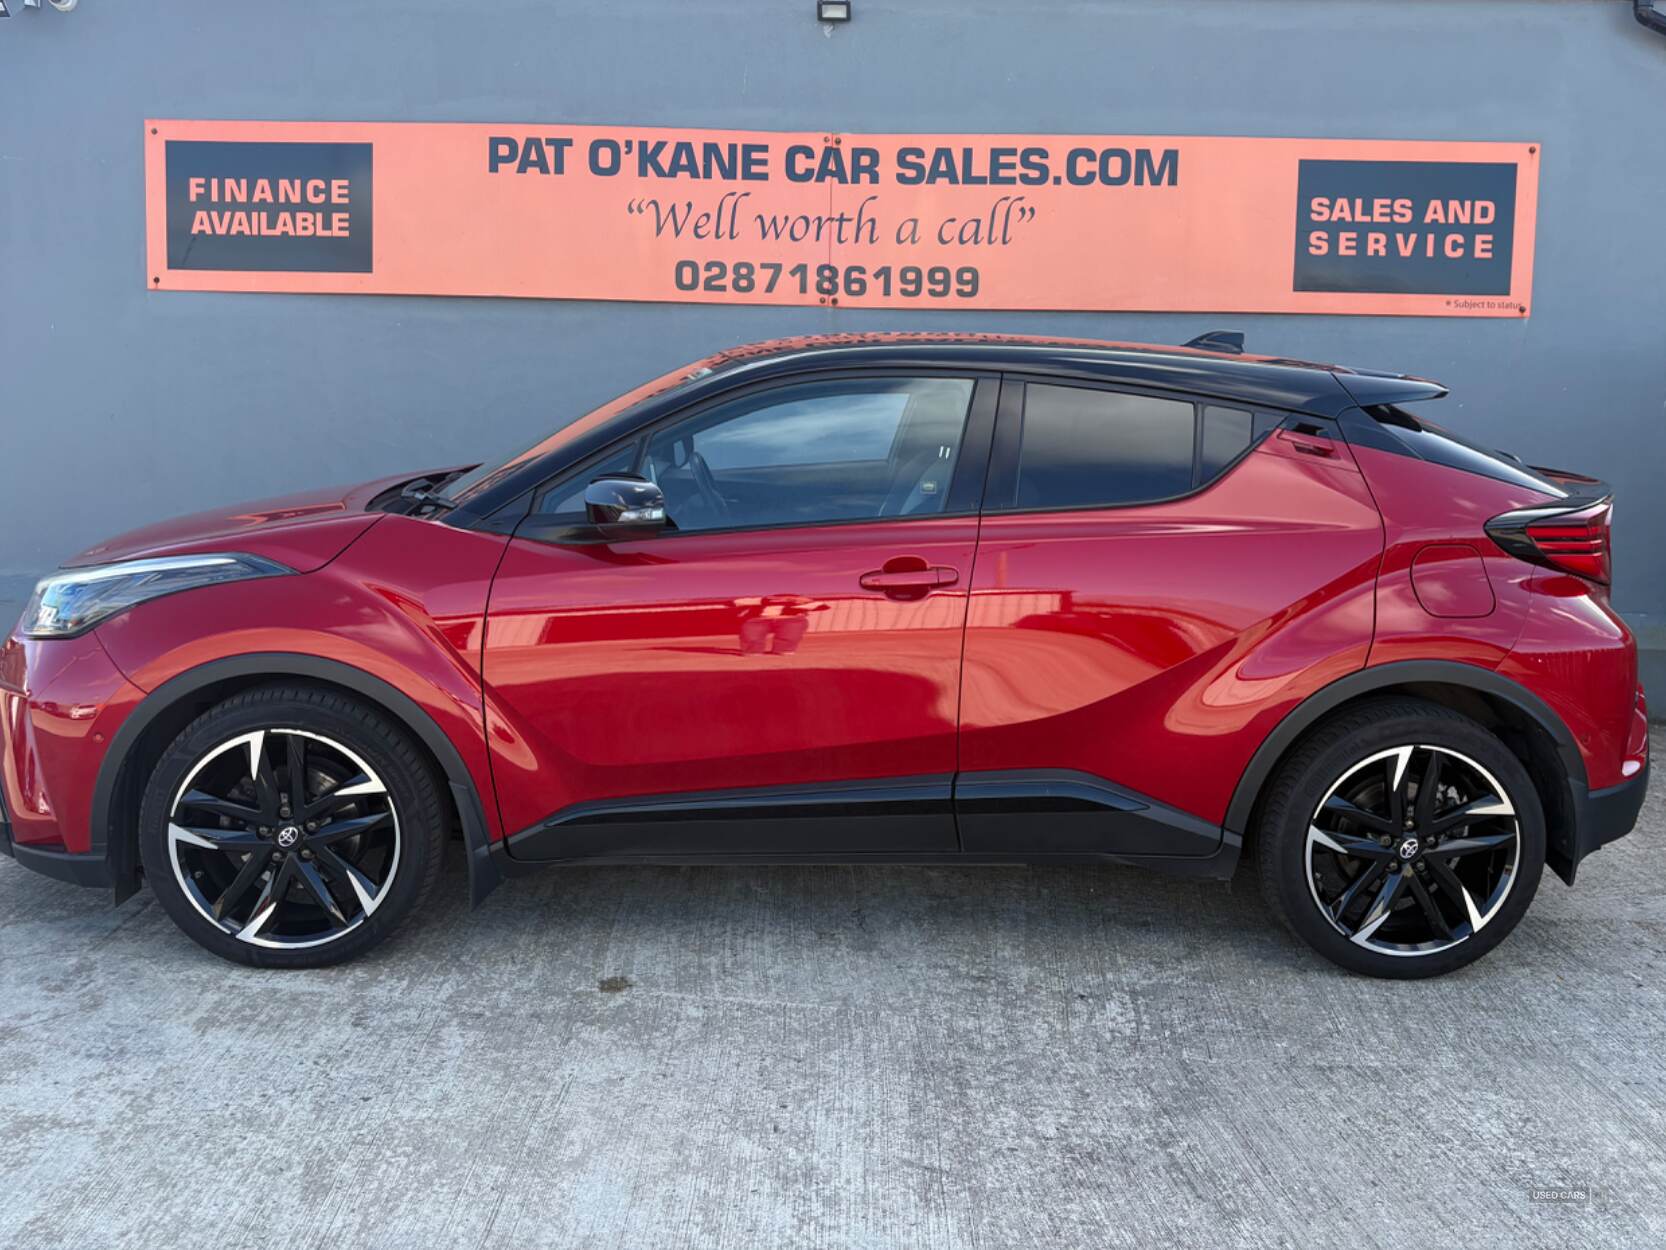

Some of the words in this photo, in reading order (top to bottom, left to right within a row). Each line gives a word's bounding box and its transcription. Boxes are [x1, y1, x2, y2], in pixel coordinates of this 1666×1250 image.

[488, 136, 573, 175] PAT
[588, 138, 769, 180] O’KANE
[784, 144, 880, 184] CAR
[895, 146, 1179, 187] SALES.COM
[188, 177, 350, 204] FINANCE
[190, 210, 350, 237] AVAILABLE
[754, 195, 879, 243] worth
[896, 218, 920, 244] a
[1310, 196, 1413, 224] SALES
[1423, 199, 1496, 225] AND
[1308, 231, 1494, 259] SERVICE
[675, 260, 980, 297] 02871861999
[1454, 299, 1485, 310] Subject
[1487, 301, 1496, 309] to
